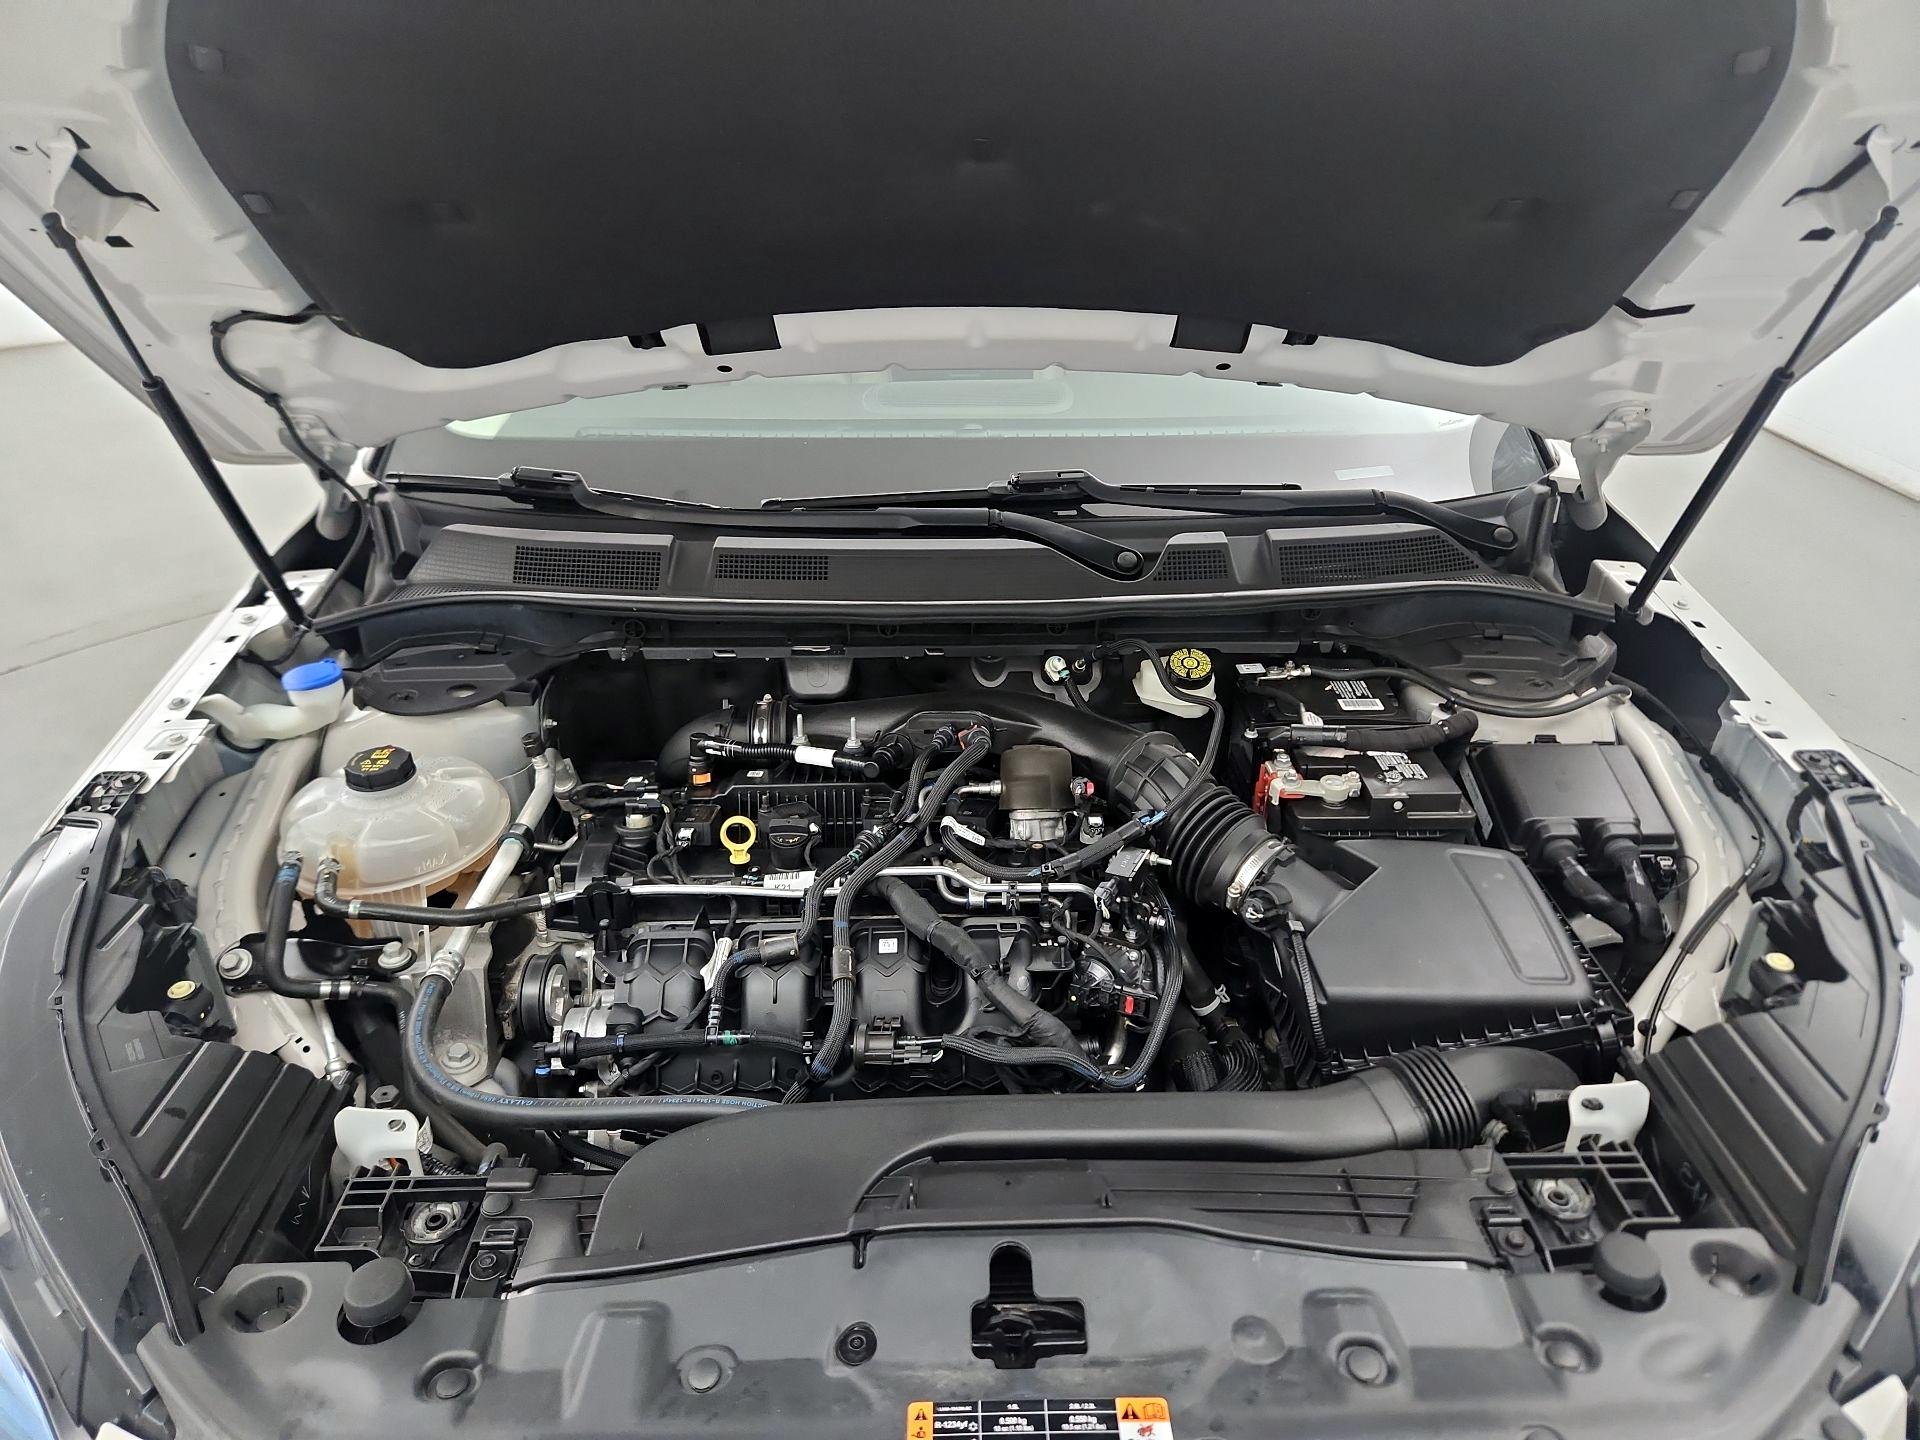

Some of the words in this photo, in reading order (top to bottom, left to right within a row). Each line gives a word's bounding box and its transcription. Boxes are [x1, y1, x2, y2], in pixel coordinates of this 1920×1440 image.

[497, 1097, 534, 1106] GALAXY
[1018, 1417, 1027, 1426] kg
[1088, 1415, 1097, 1424] kg
[934, 1420, 968, 1430] R-1234yf
